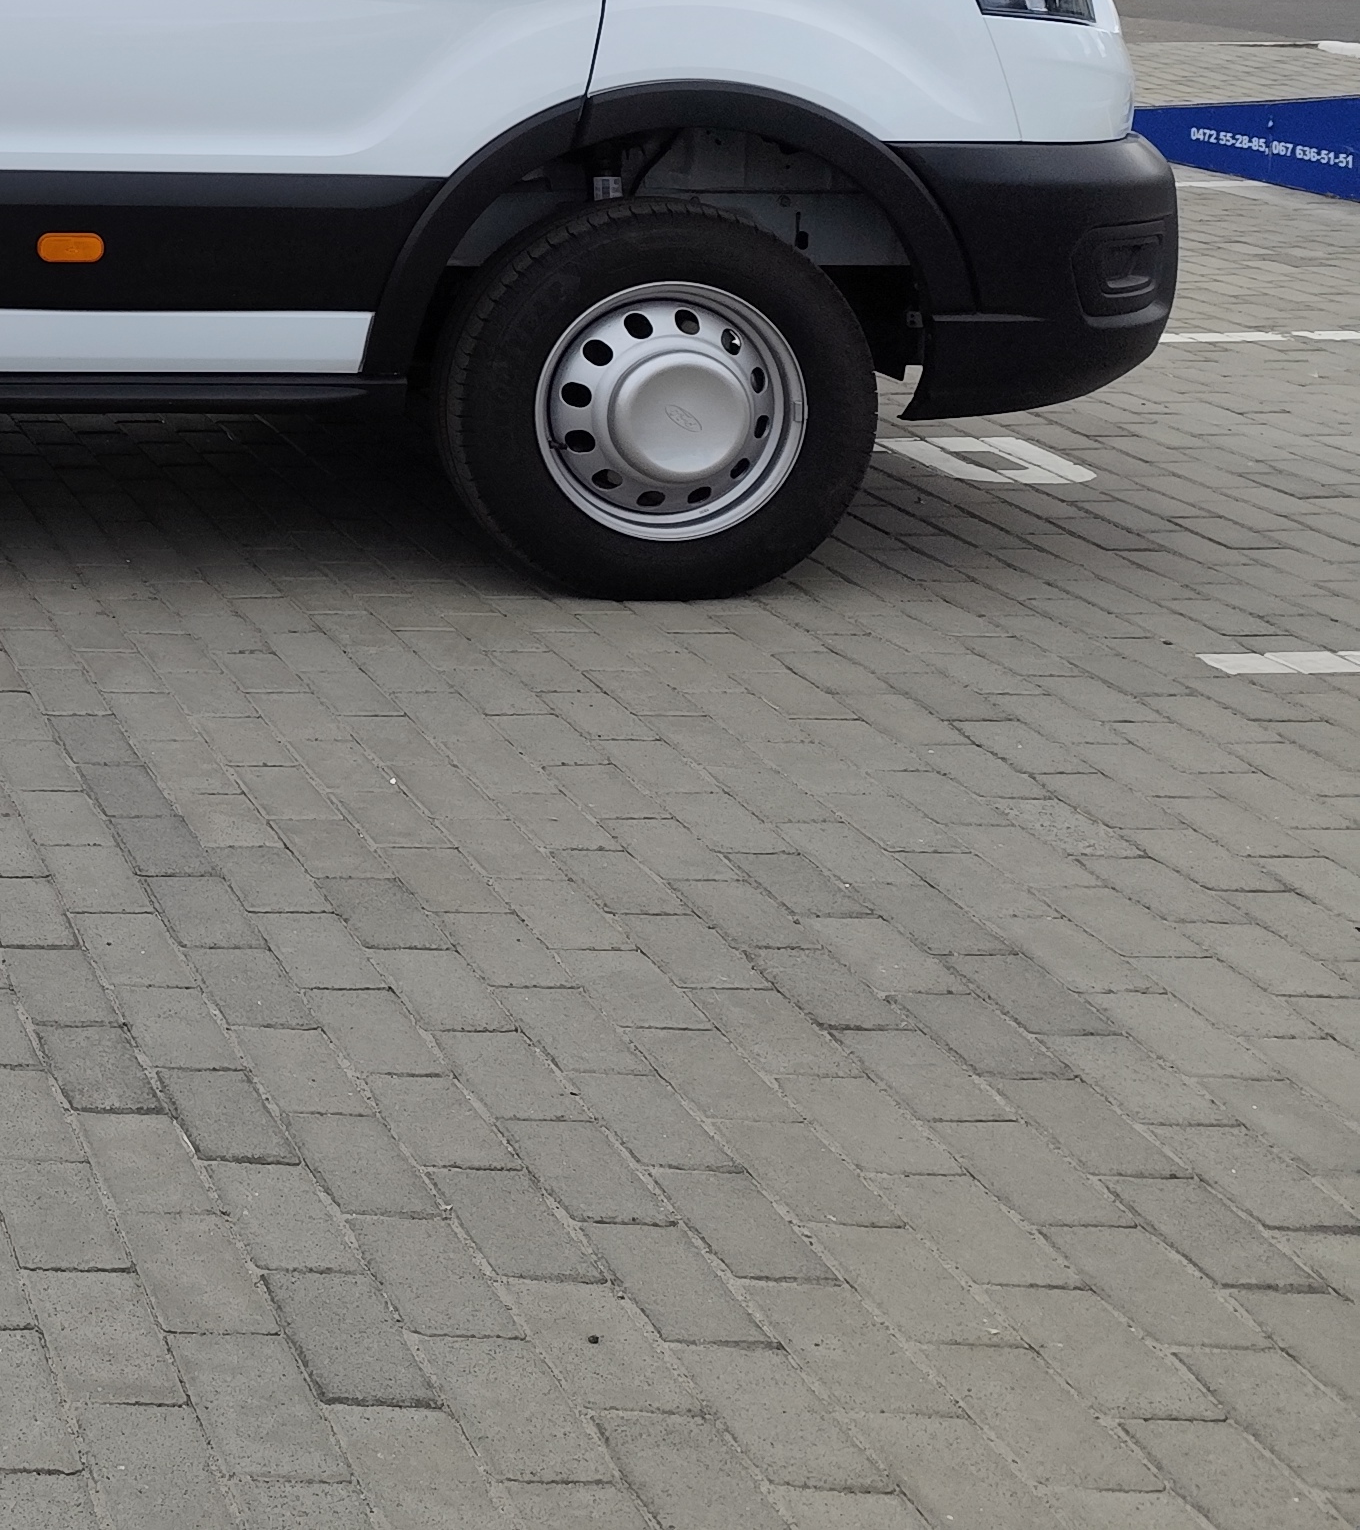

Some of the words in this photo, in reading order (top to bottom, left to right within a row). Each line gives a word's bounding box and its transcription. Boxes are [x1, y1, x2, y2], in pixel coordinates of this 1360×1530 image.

[1191, 127, 1217, 143] 0472
[1219, 132, 1269, 155] 55-28-85,
[1272, 141, 1294, 156] 067
[1295, 145, 1353, 169] 636-51-51
